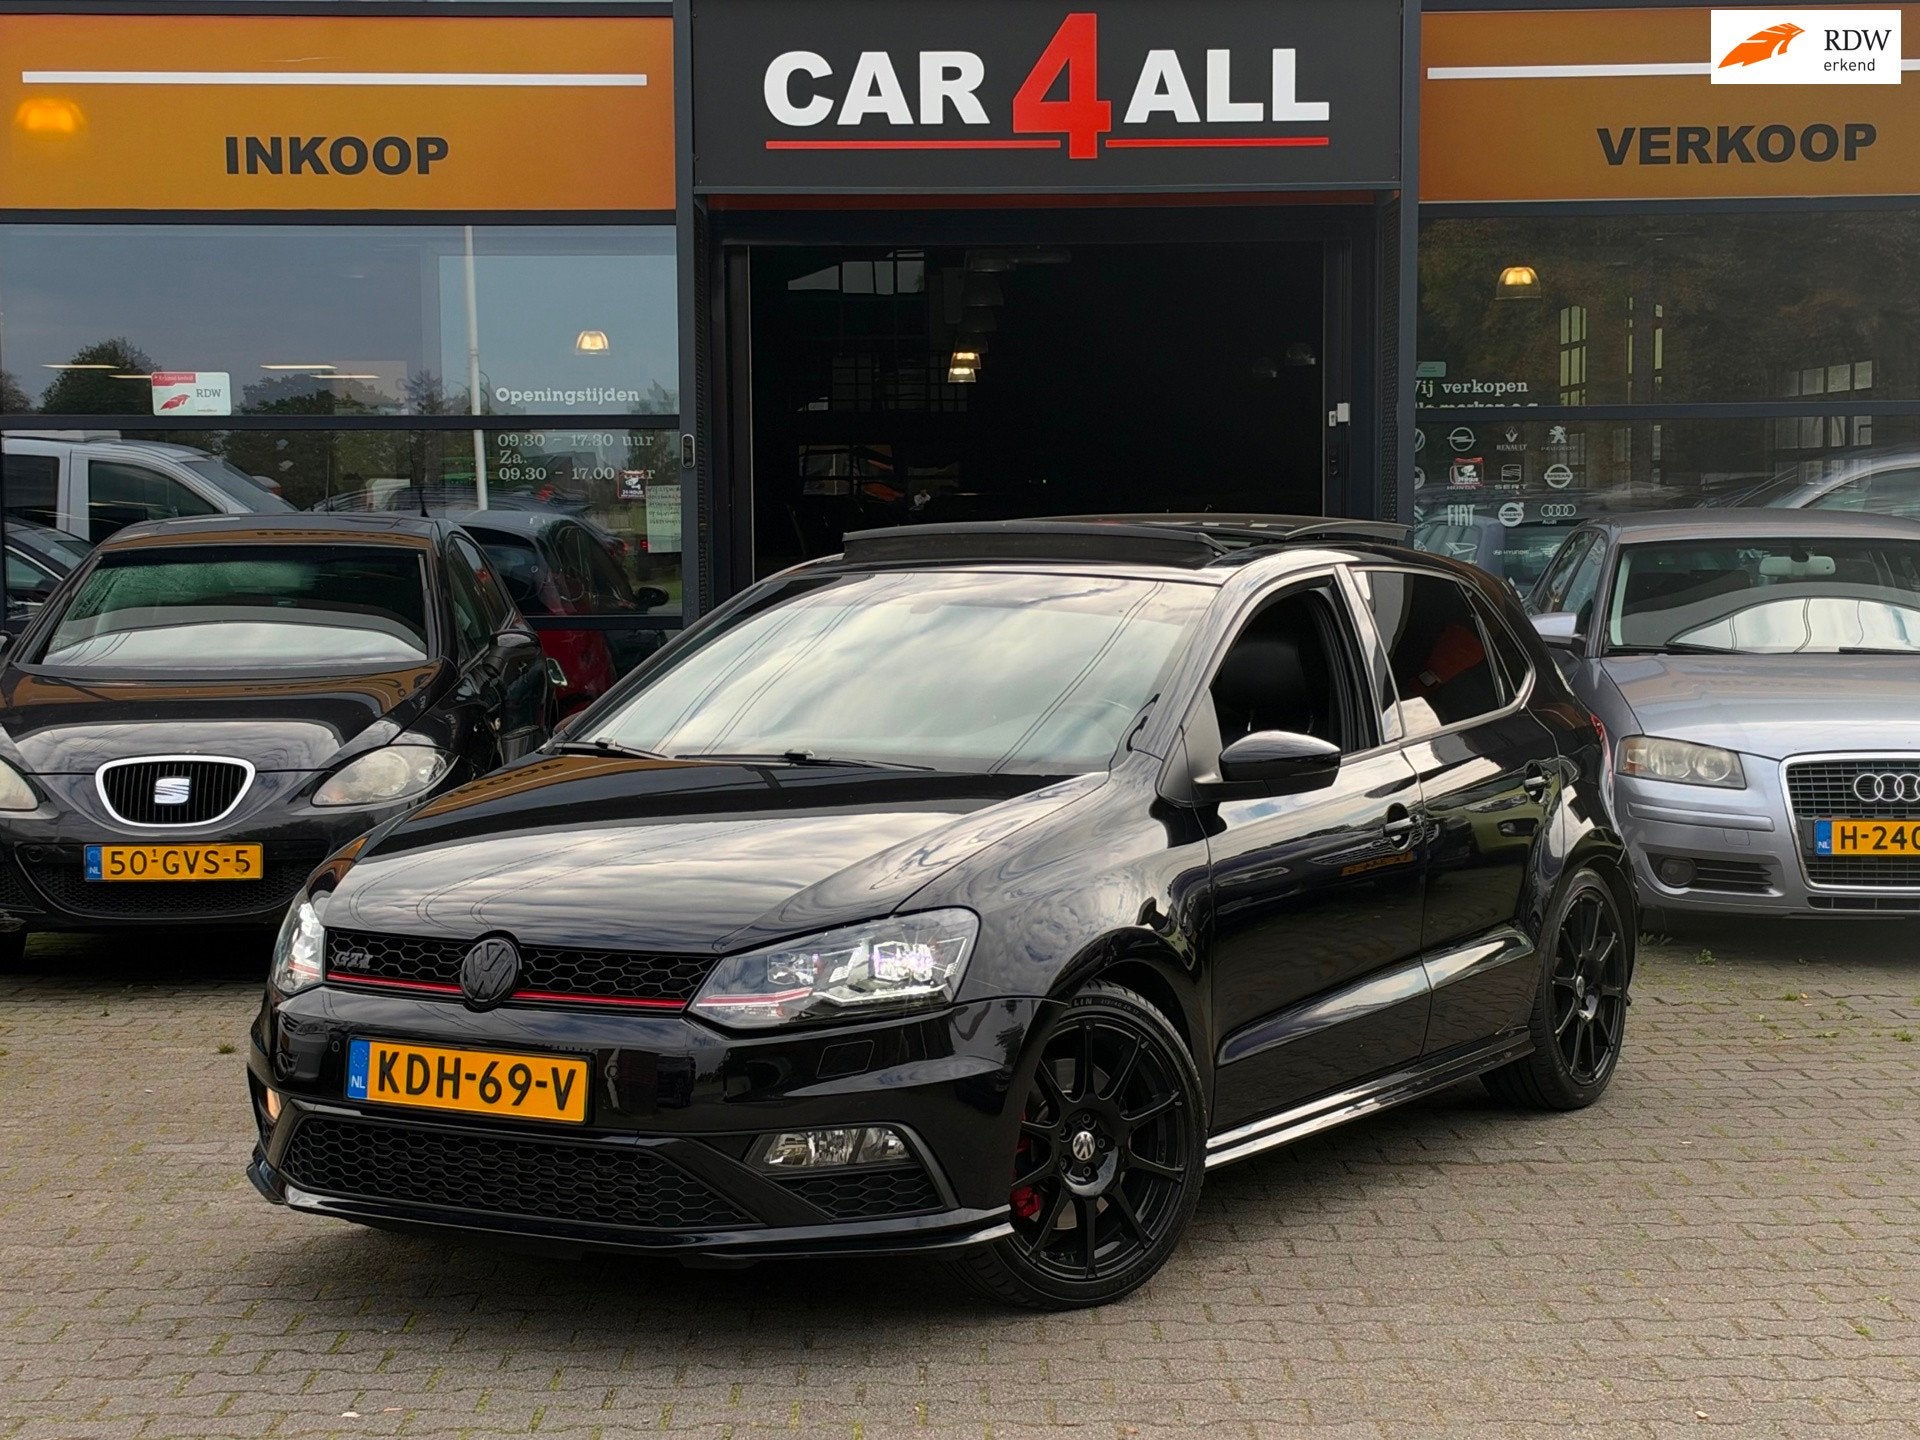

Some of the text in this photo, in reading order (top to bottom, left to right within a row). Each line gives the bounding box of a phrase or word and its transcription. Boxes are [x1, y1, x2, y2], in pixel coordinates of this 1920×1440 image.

[763, 13, 1330, 159] CAR 4 ALL
[1596, 123, 1877, 165] VERKOOP
[225, 136, 449, 175] INKOOP
[196, 388, 222, 398] RDW
[495, 387, 640, 405] Openingstijden
[1441, 379, 1529, 397] verkopen
[497, 434, 546, 447] 09.30
[571, 433, 614, 447] 17.30
[622, 434, 655, 446] uur
[499, 450, 528, 465] Za.
[498, 467, 547, 480] 09.30
[571, 467, 615, 480] 17.00
[1447, 504, 1475, 526] FIAT
[1817, 841, 1830, 849] NL
[89, 866, 101, 875] NL
[351, 1075, 366, 1089] NL
[378, 1050, 576, 1111] KDH-69-V
